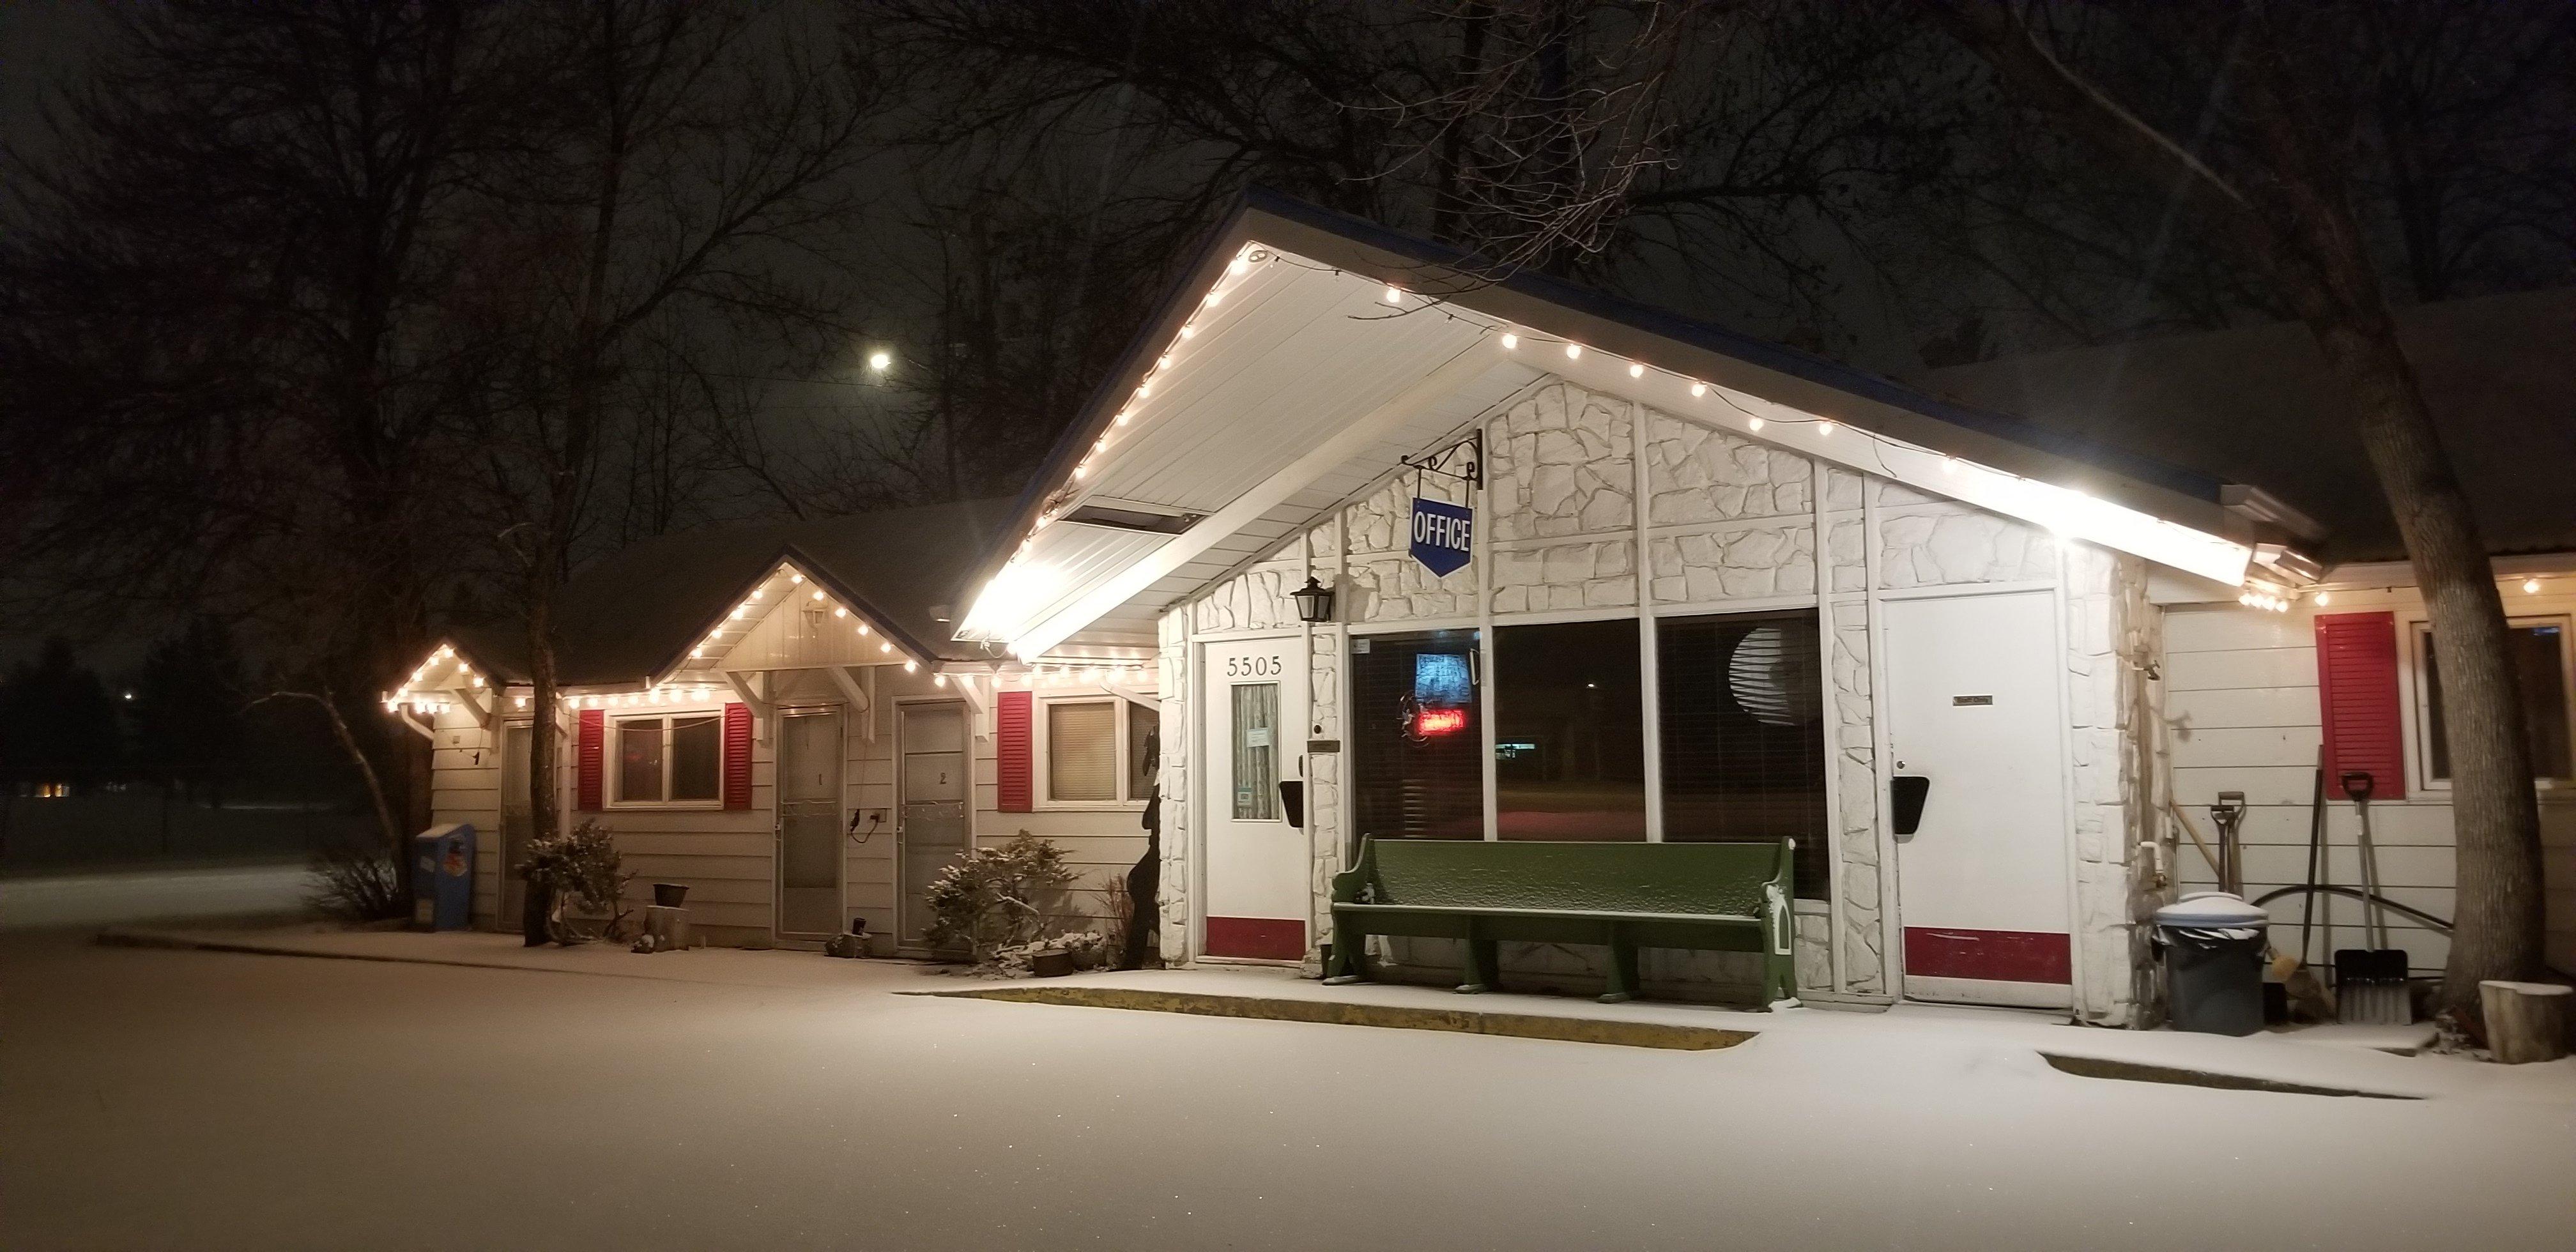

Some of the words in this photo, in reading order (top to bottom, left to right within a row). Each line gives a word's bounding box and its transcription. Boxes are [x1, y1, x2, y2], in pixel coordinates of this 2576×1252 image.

[1414, 512, 1471, 551] OFFICE
[1227, 656, 1281, 676] 5505
[939, 772, 947, 784] 2
